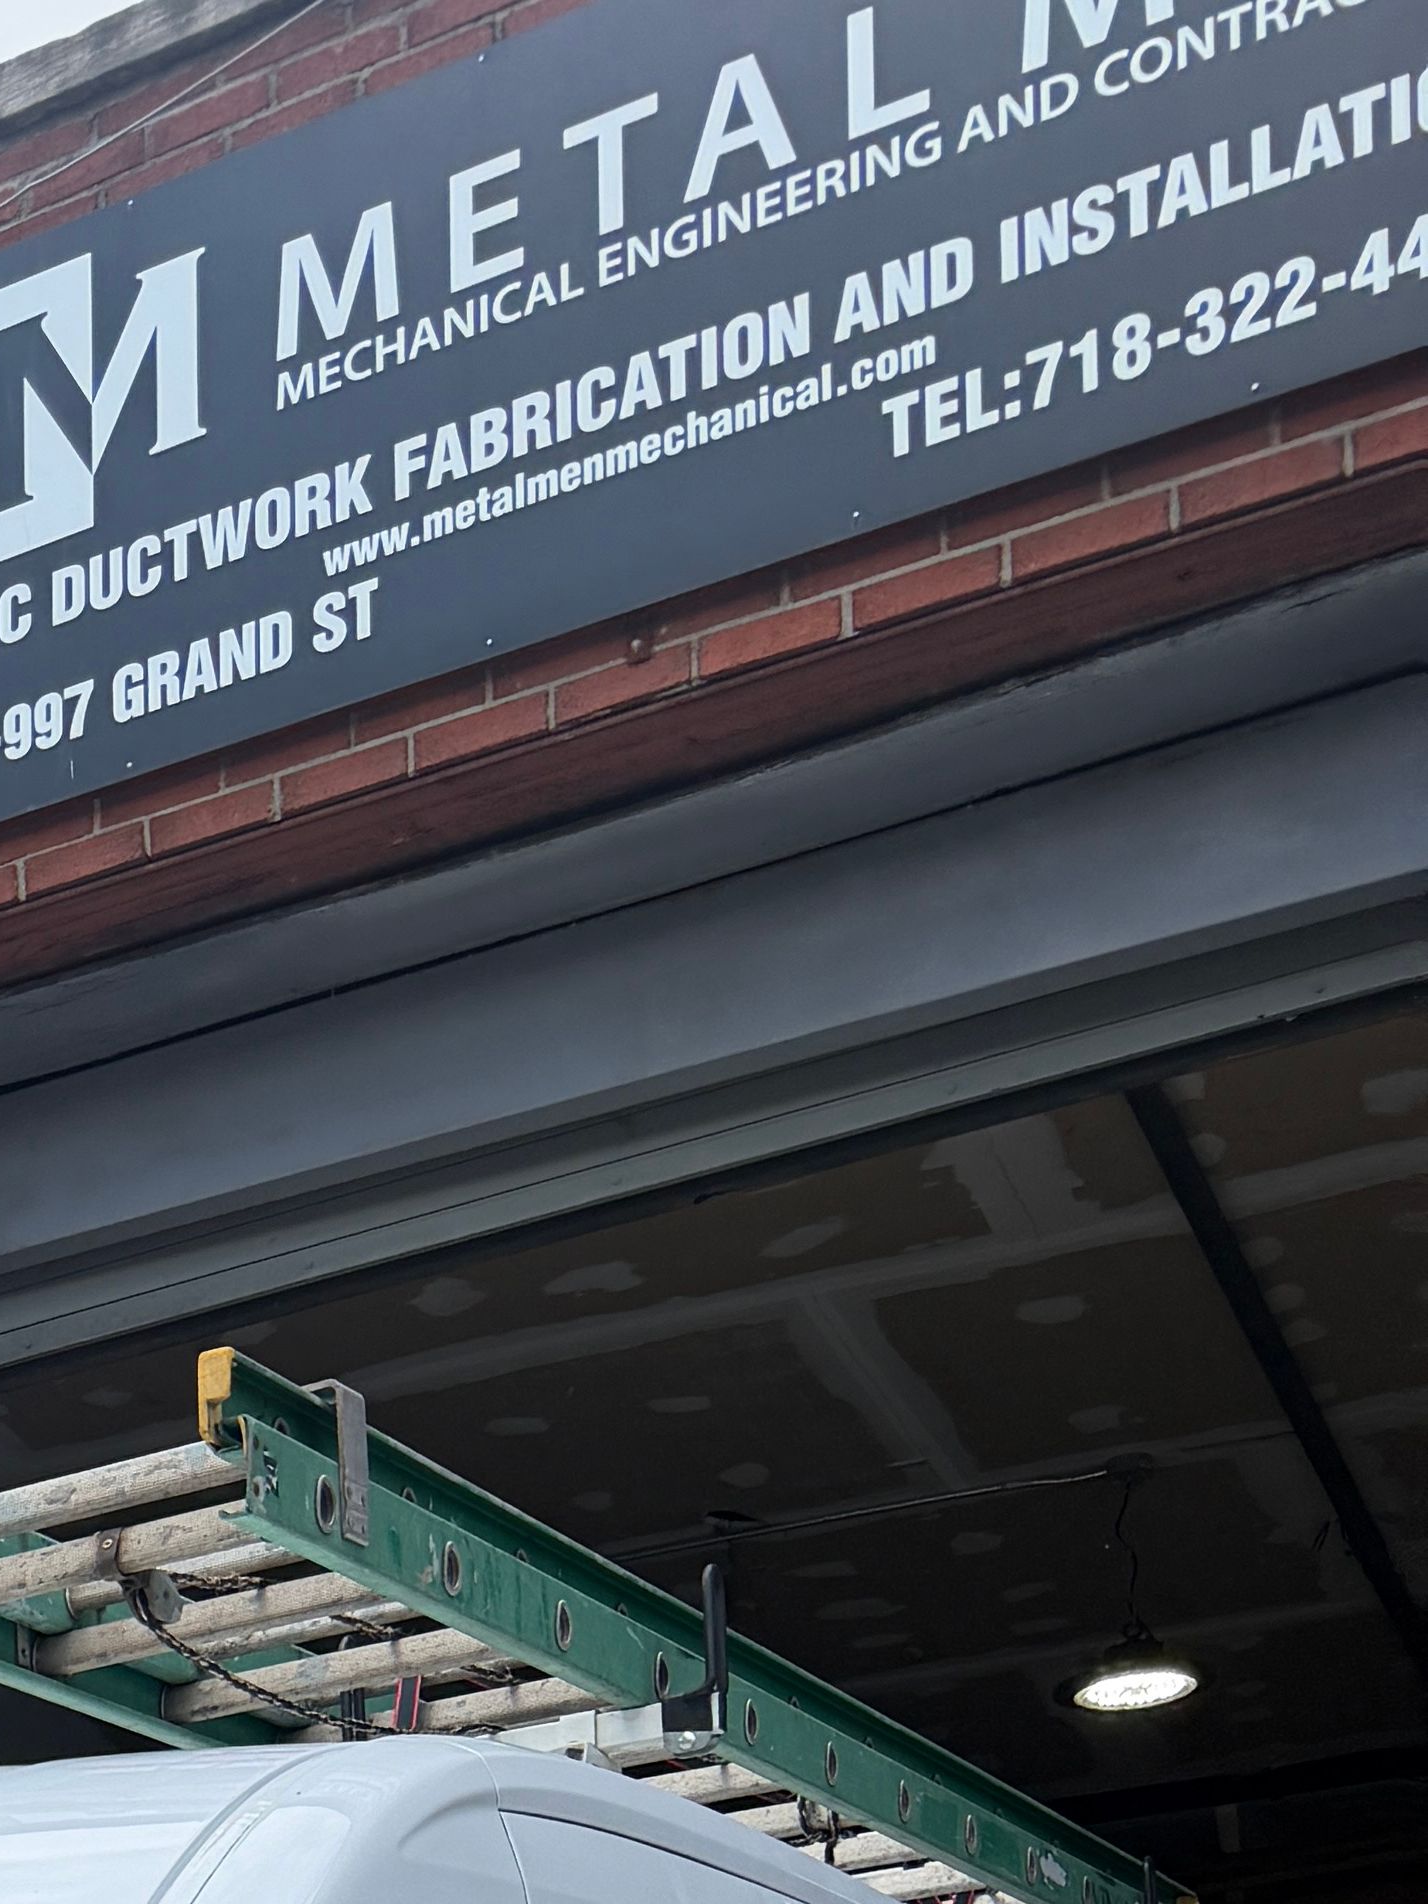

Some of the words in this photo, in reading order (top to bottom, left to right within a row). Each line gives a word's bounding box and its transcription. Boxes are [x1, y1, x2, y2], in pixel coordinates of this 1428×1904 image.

[51, 453, 374, 627] DUCTWORK
[394, 291, 811, 501] FABRICATION
[833, 236, 975, 344] AND
[999, 63, 1428, 285] INSTALLATI
[275, 5, 932, 362] METAL
[275, 262, 585, 411] MECHANICAL
[598, 121, 943, 288] ENGINEERING
[956, 72, 1080, 154] AND
[322, 335, 937, 577] www.metalmenmechanical.com
[112, 610, 293, 725] GRAND
[311, 577, 379, 655] ST
